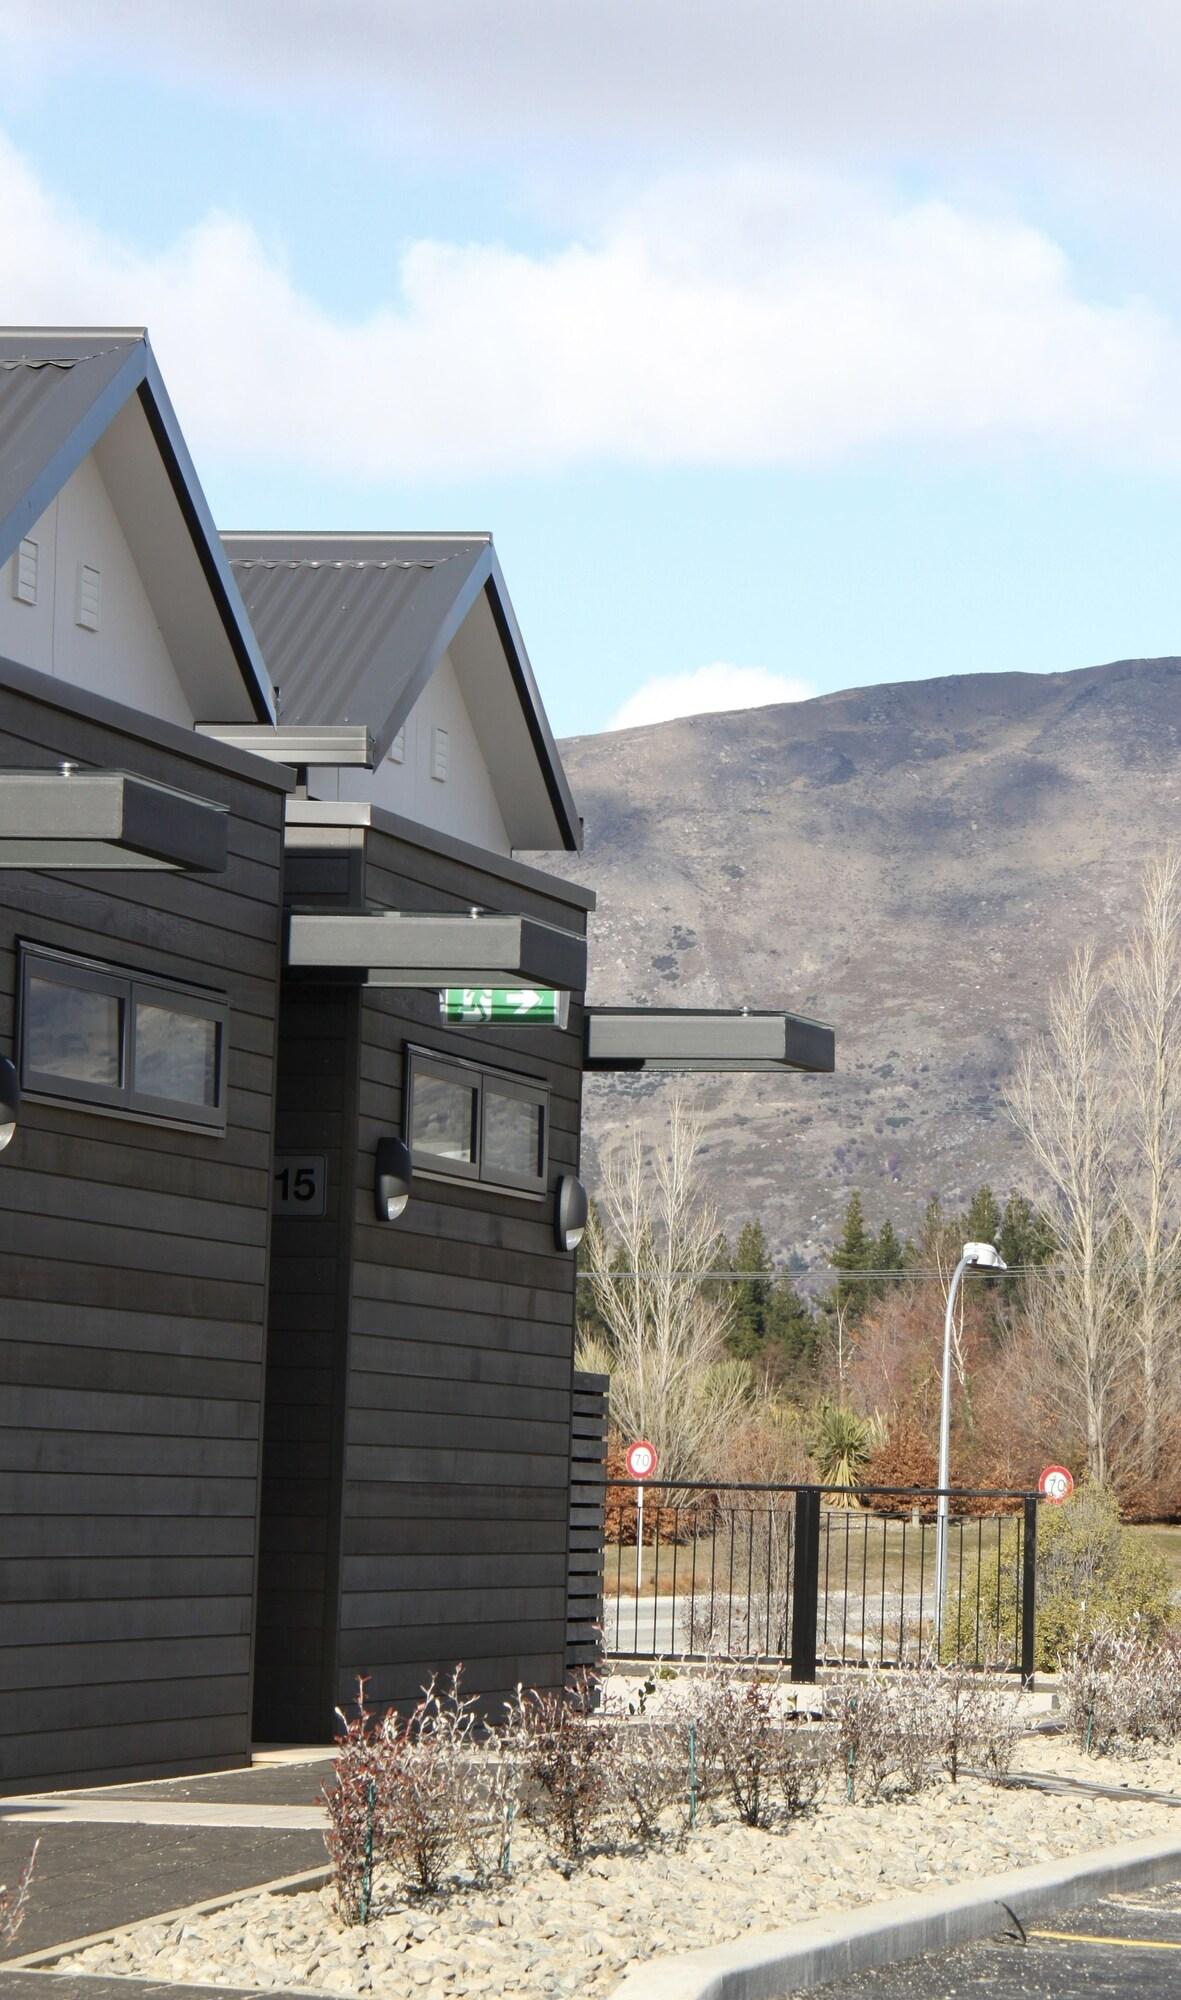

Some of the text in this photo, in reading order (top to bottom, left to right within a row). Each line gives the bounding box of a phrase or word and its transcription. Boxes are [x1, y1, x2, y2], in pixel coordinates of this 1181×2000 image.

[274, 1168, 315, 1201] 15
[635, 1454, 649, 1467] 70
[1049, 1479, 1065, 1494] 70
